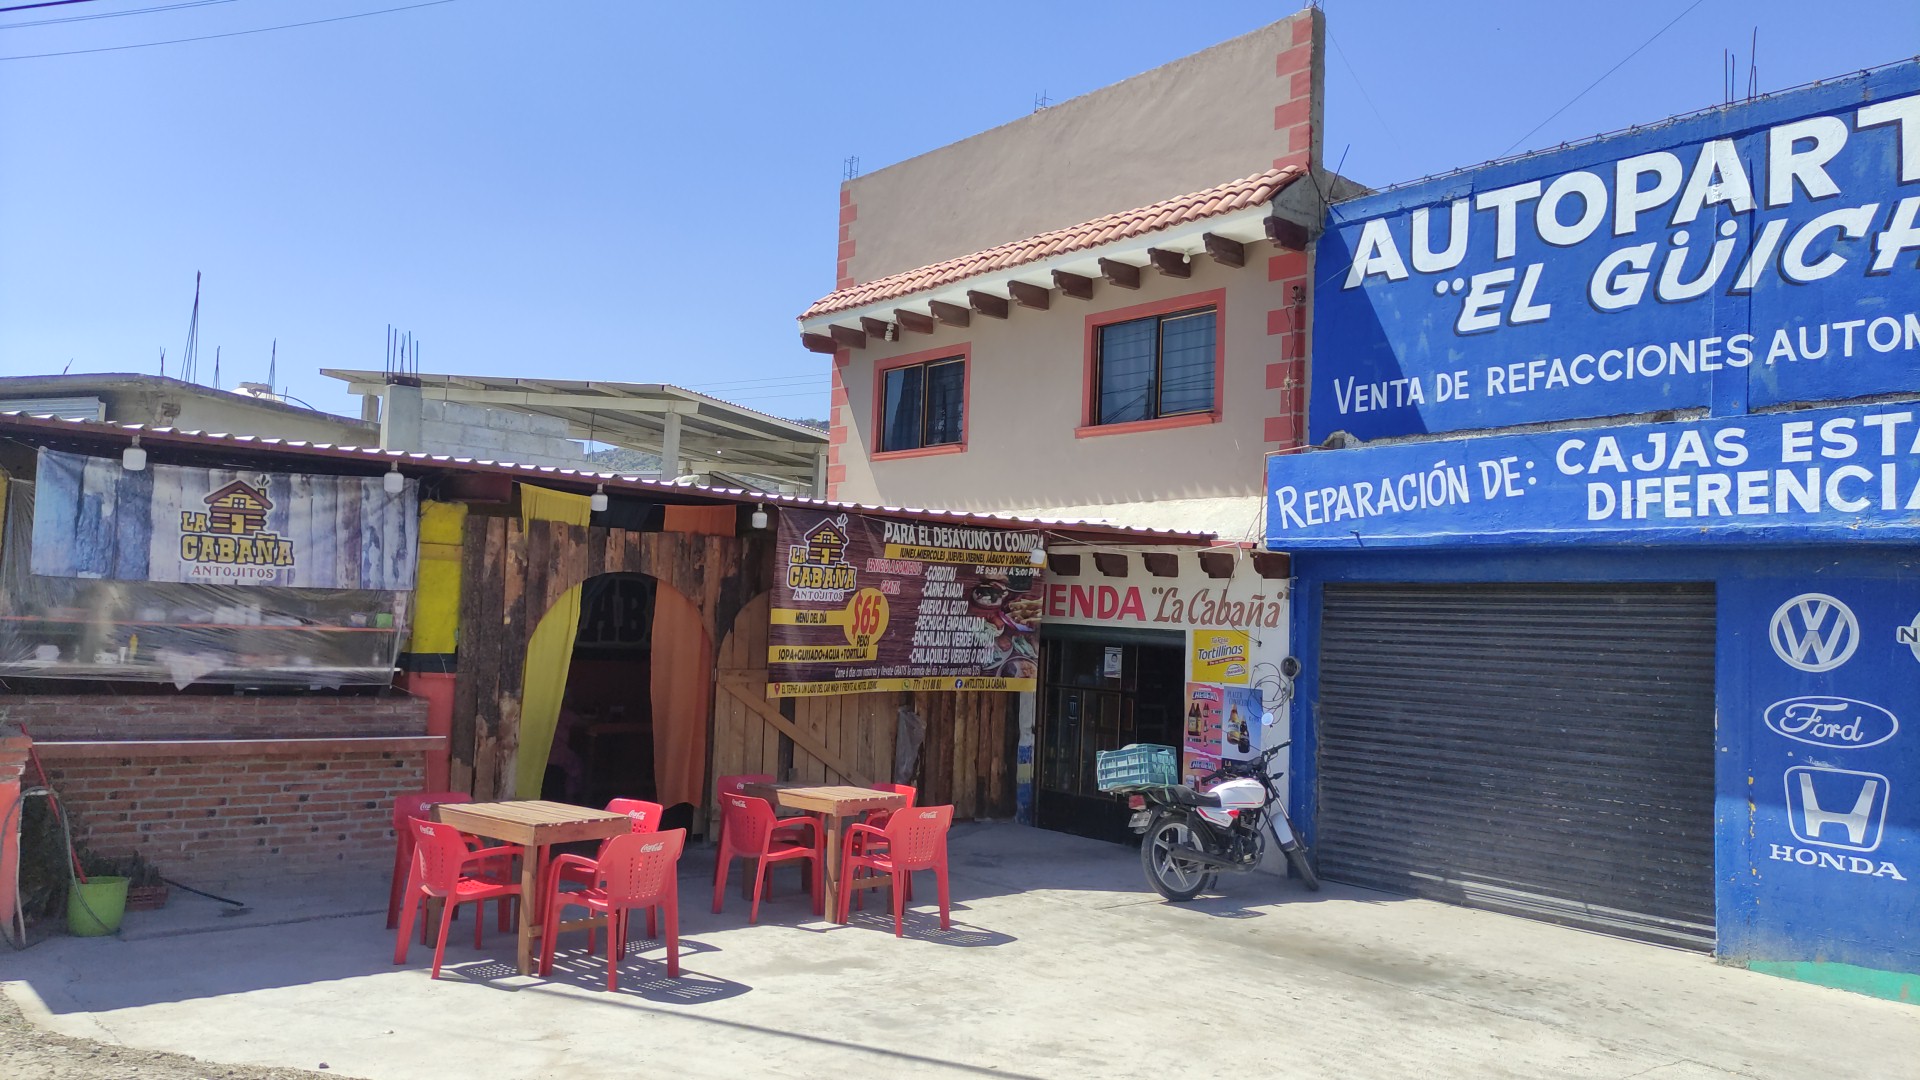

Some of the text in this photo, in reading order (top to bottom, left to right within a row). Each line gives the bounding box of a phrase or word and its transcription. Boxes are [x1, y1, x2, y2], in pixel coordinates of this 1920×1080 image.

[1343, 94, 1920, 289] AUTOPART
[1334, 375, 1425, 415] VENTA
[1436, 370, 1470, 403] DE
[1487, 334, 1755, 397] REFACCIONES
[1555, 411, 1920, 475] CAJAS EST
[1276, 456, 1537, 529] REPARACIÓN DE:
[181, 511, 208, 533] LA
[883, 522, 916, 544] PARA
[918, 525, 931, 547] EL
[934, 526, 992, 551] DESAYUNO
[993, 532, 1002, 551] O
[181, 532, 294, 567] CABAÑA
[790, 546, 808, 564] LA
[192, 565, 275, 579] ANTOJITOS
[789, 563, 856, 589] CABAÑA
[975, 565, 984, 574] DE
[1009, 567, 1014, 575] A
[794, 590, 845, 600] ANTOJITOS
[881, 580, 900, 595] GRATIS
[944, 583, 964, 598] ASADA
[941, 600, 949, 614] AL
[950, 600, 968, 615] GUSTO
[1042, 583, 1147, 622] IENDA
[810, 612, 819, 623] DEL
[852, 591, 881, 639] $65
[945, 616, 985, 631] EMPANIZADA
[856, 635, 870, 647] PESOS
[951, 632, 974, 647] VERDES
[950, 648, 971, 663] VERDES
[1198, 645, 1243, 660] Tortillinas
[964, 679, 984, 689] ANTOJITOS
[1780, 702, 1864, 742] Ford
[1769, 843, 1907, 881] HONDA
